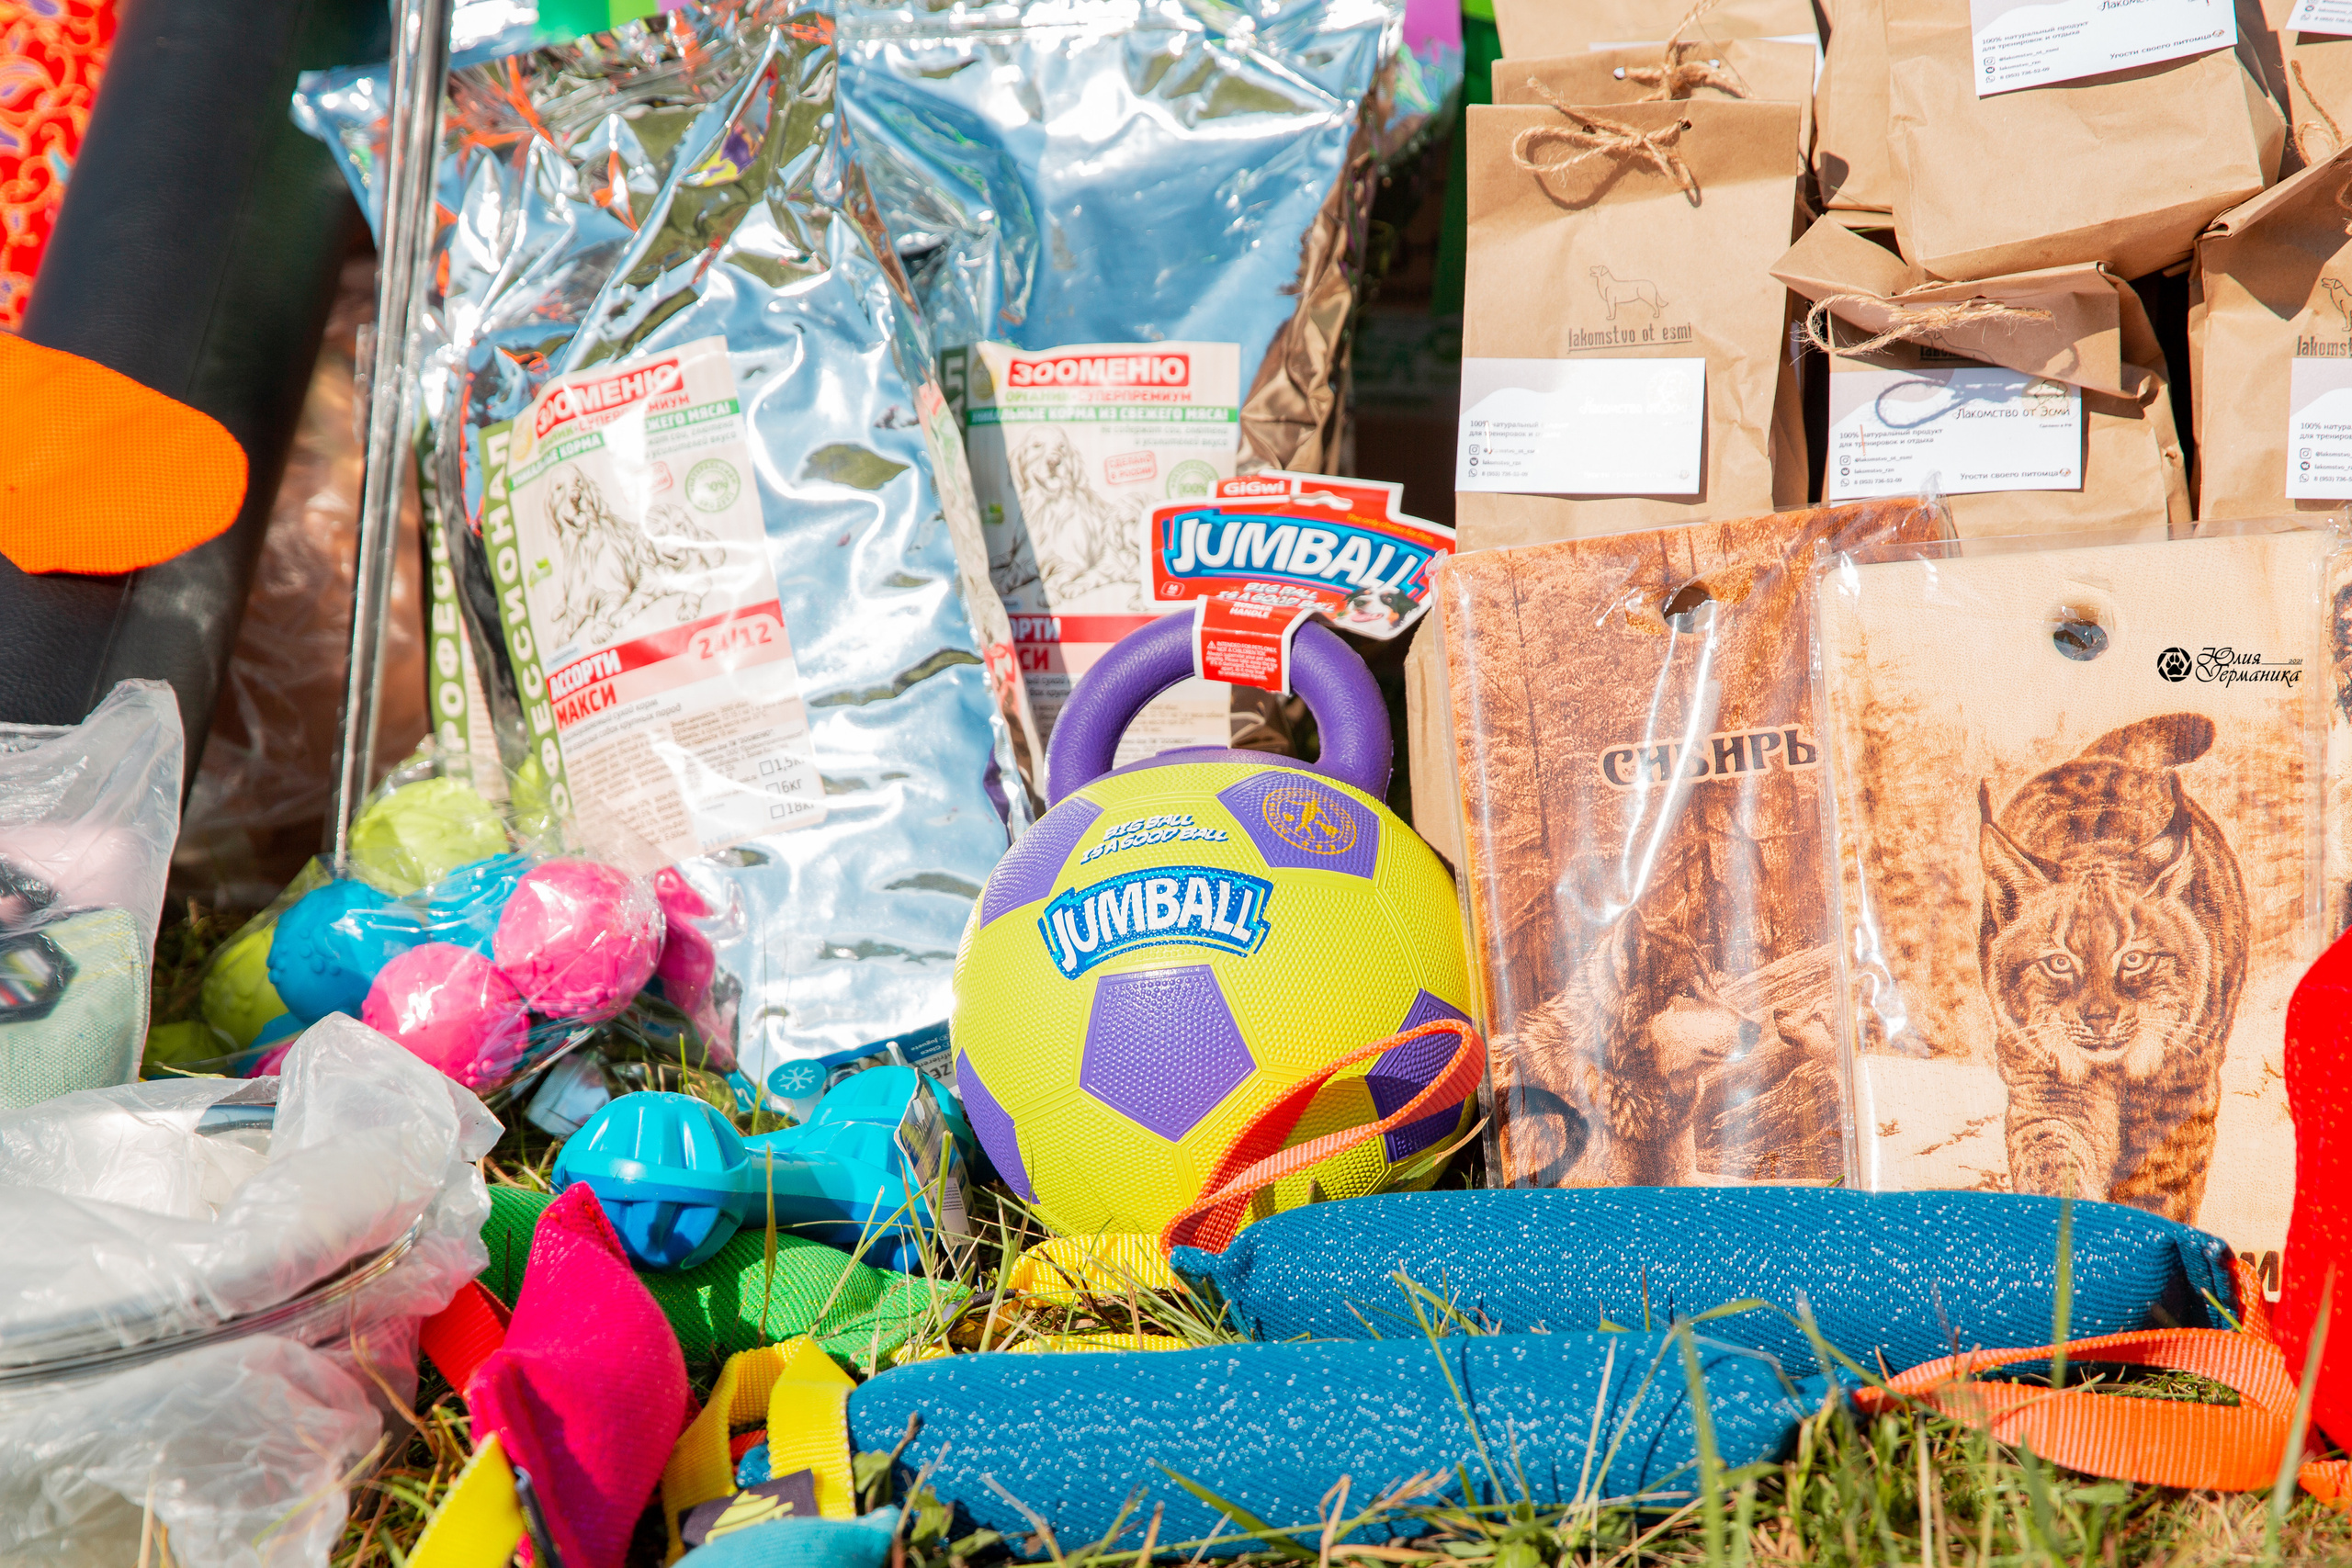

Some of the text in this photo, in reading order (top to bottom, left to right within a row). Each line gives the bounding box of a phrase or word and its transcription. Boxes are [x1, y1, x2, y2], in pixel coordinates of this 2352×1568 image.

[1568, 322, 1691, 347] lakomstvo ot esmi
[1012, 355, 1186, 385] ЗООМЕНЮ
[1049, 408, 1096, 421] КОРМА
[1119, 409, 1182, 421] СВЕЖЕГО
[1955, 408, 2018, 420] Лакомство
[2040, 406, 2070, 417] Эсми
[2324, 423, 2352, 432] натура
[560, 434, 602, 457] КОРМА
[1960, 472, 1988, 480] Угости
[1224, 481, 1284, 496] GiGwi
[1172, 518, 1419, 592] JUMBALL
[1238, 592, 1250, 602] A
[1250, 593, 1300, 605] GOOD
[1244, 582, 1317, 601] BIG BALL
[487, 429, 571, 810] ОФЕССИОНАЛ
[1229, 607, 1270, 619] HANDLE
[698, 623, 772, 660] 24/12
[550, 649, 621, 703] АССОРТИ
[557, 682, 616, 729] МАКСИ
[655, 703, 682, 718] пород
[775, 758, 806, 773] 1,5к
[1603, 729, 1817, 786] СИБИРЬ
[787, 801, 815, 815] 18к
[1103, 814, 1194, 841] BIG BALL
[1080, 828, 1229, 865] IS A GOOD BALL
[1050, 876, 1255, 973] JUMBALL
